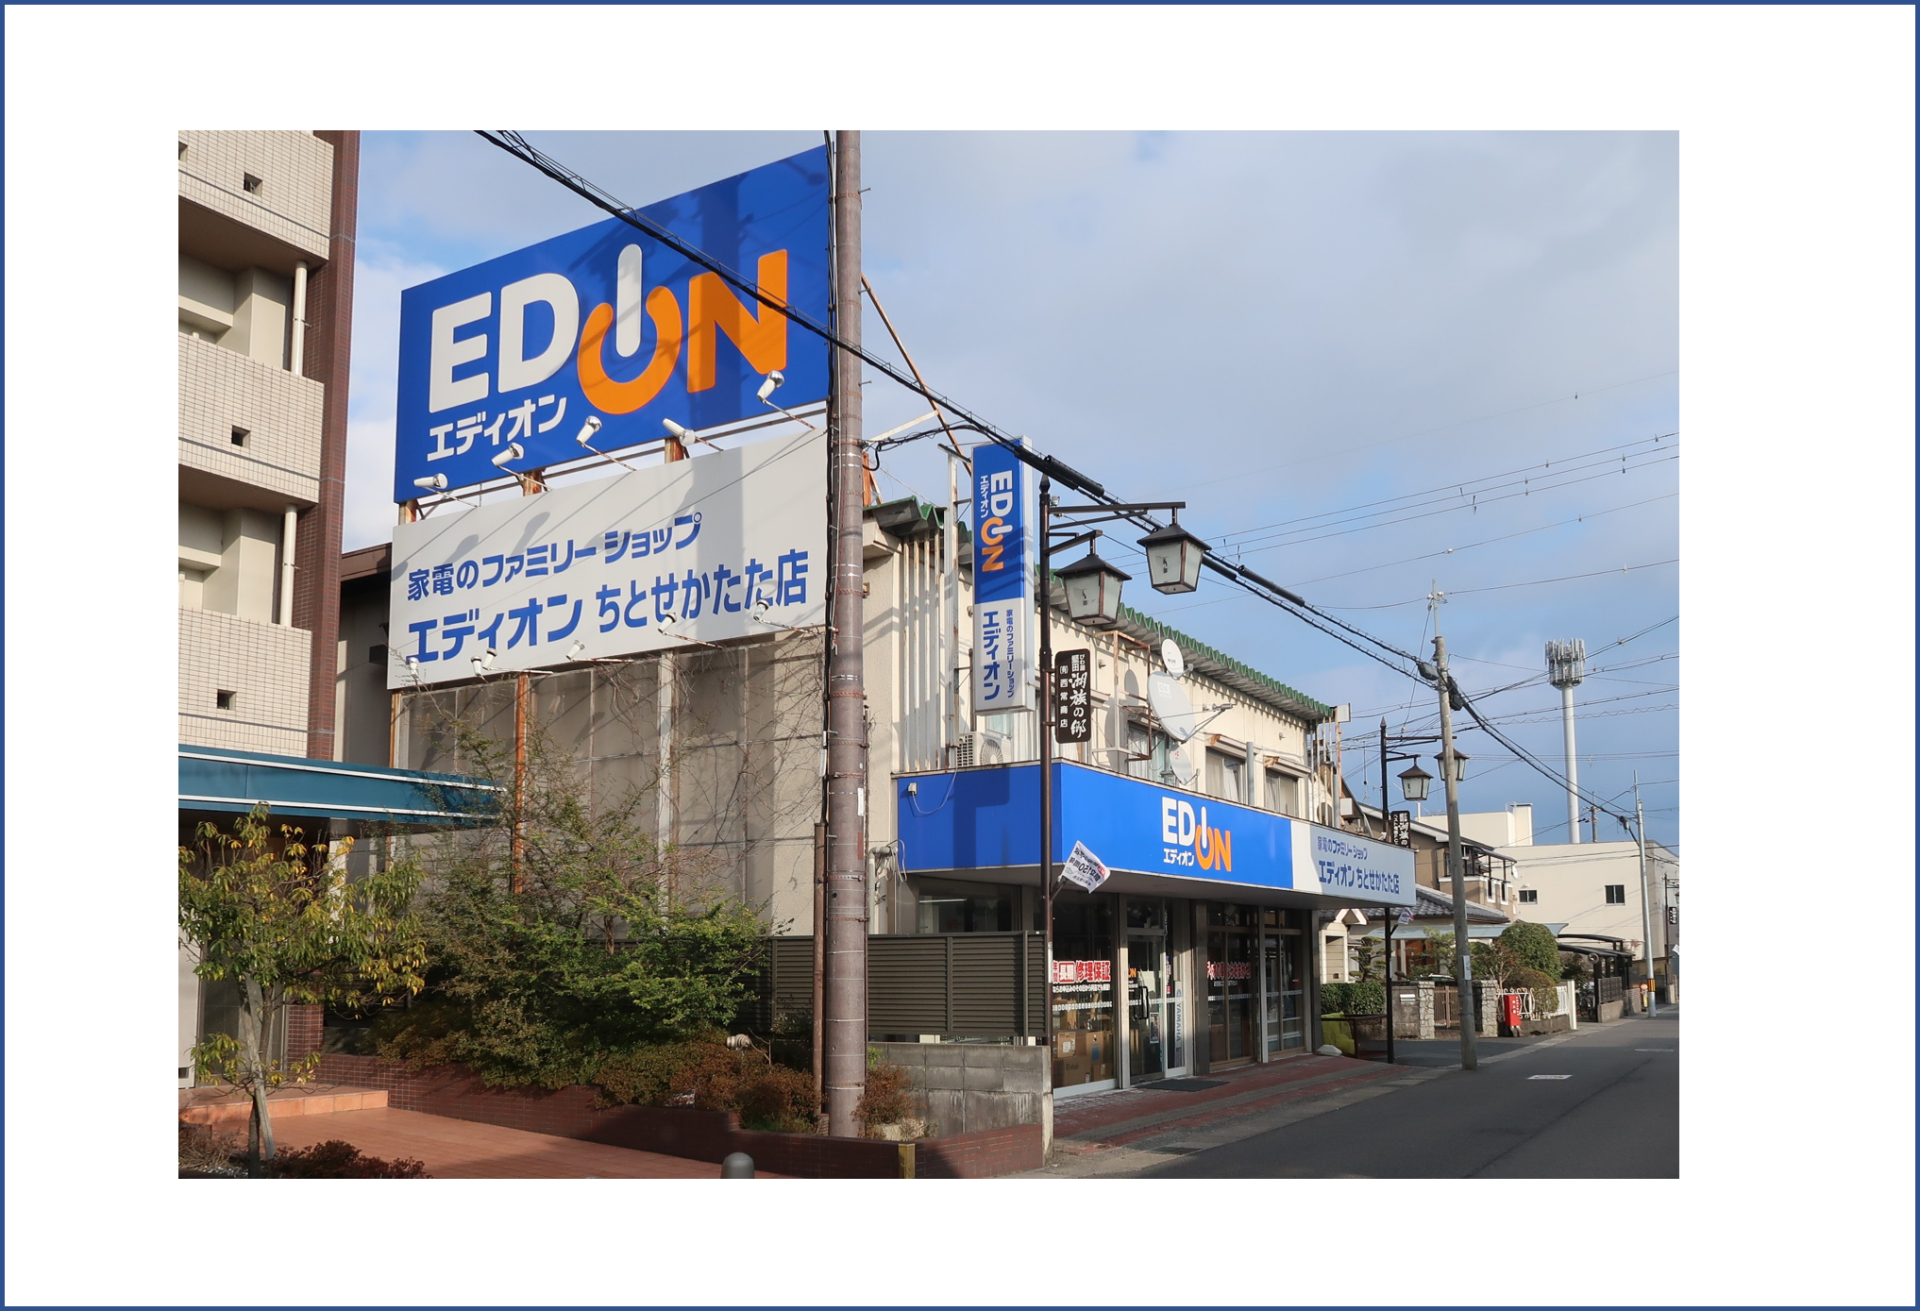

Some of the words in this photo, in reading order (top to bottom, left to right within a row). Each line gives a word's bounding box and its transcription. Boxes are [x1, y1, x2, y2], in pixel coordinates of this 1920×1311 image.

[429, 243, 788, 415] EDION
[427, 393, 567, 462] エディオン
[980, 475, 989, 518] エディオン
[981, 470, 1013, 572] EDION
[405, 594, 583, 664] エディオン
[596, 549, 810, 634] ちとせかたた店
[982, 610, 1001, 701] エディオン
[1006, 609, 1015, 699] 家電のファミリーショップ
[1162, 796, 1232, 872] EDION
[1163, 848, 1195, 867] エディオン
[1318, 860, 1355, 887] エディオン
[1356, 867, 1400, 894] ちとせかたた店
